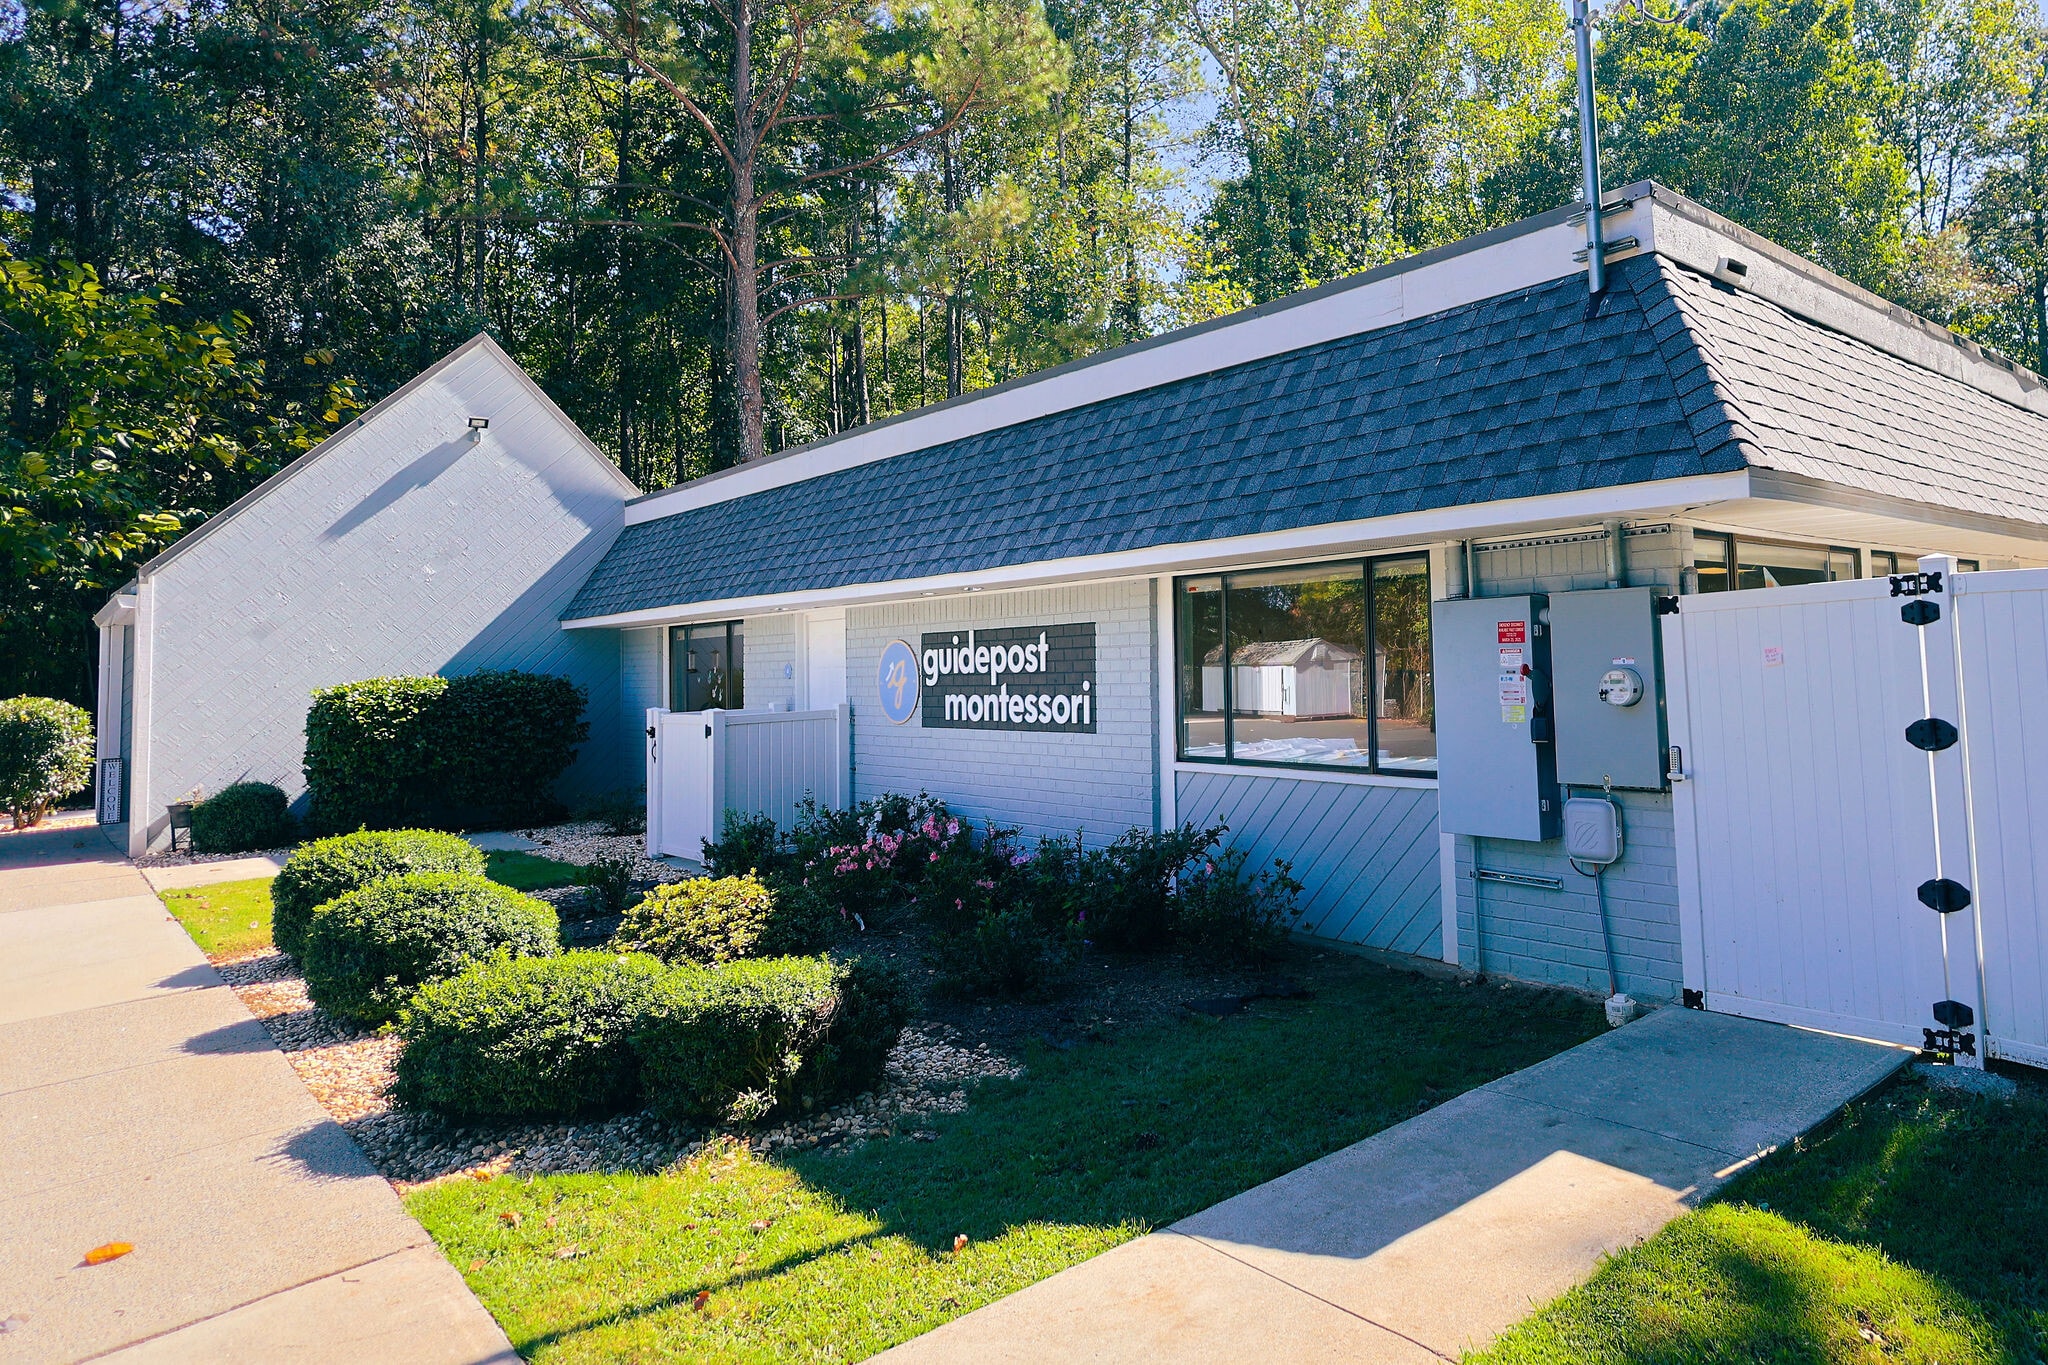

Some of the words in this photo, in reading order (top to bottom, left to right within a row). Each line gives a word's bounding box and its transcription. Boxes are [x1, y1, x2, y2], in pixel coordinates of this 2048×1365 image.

[922, 630, 1049, 687] guidepost
[945, 680, 1091, 725] montessori
[107, 763, 118, 820] WELCOME
